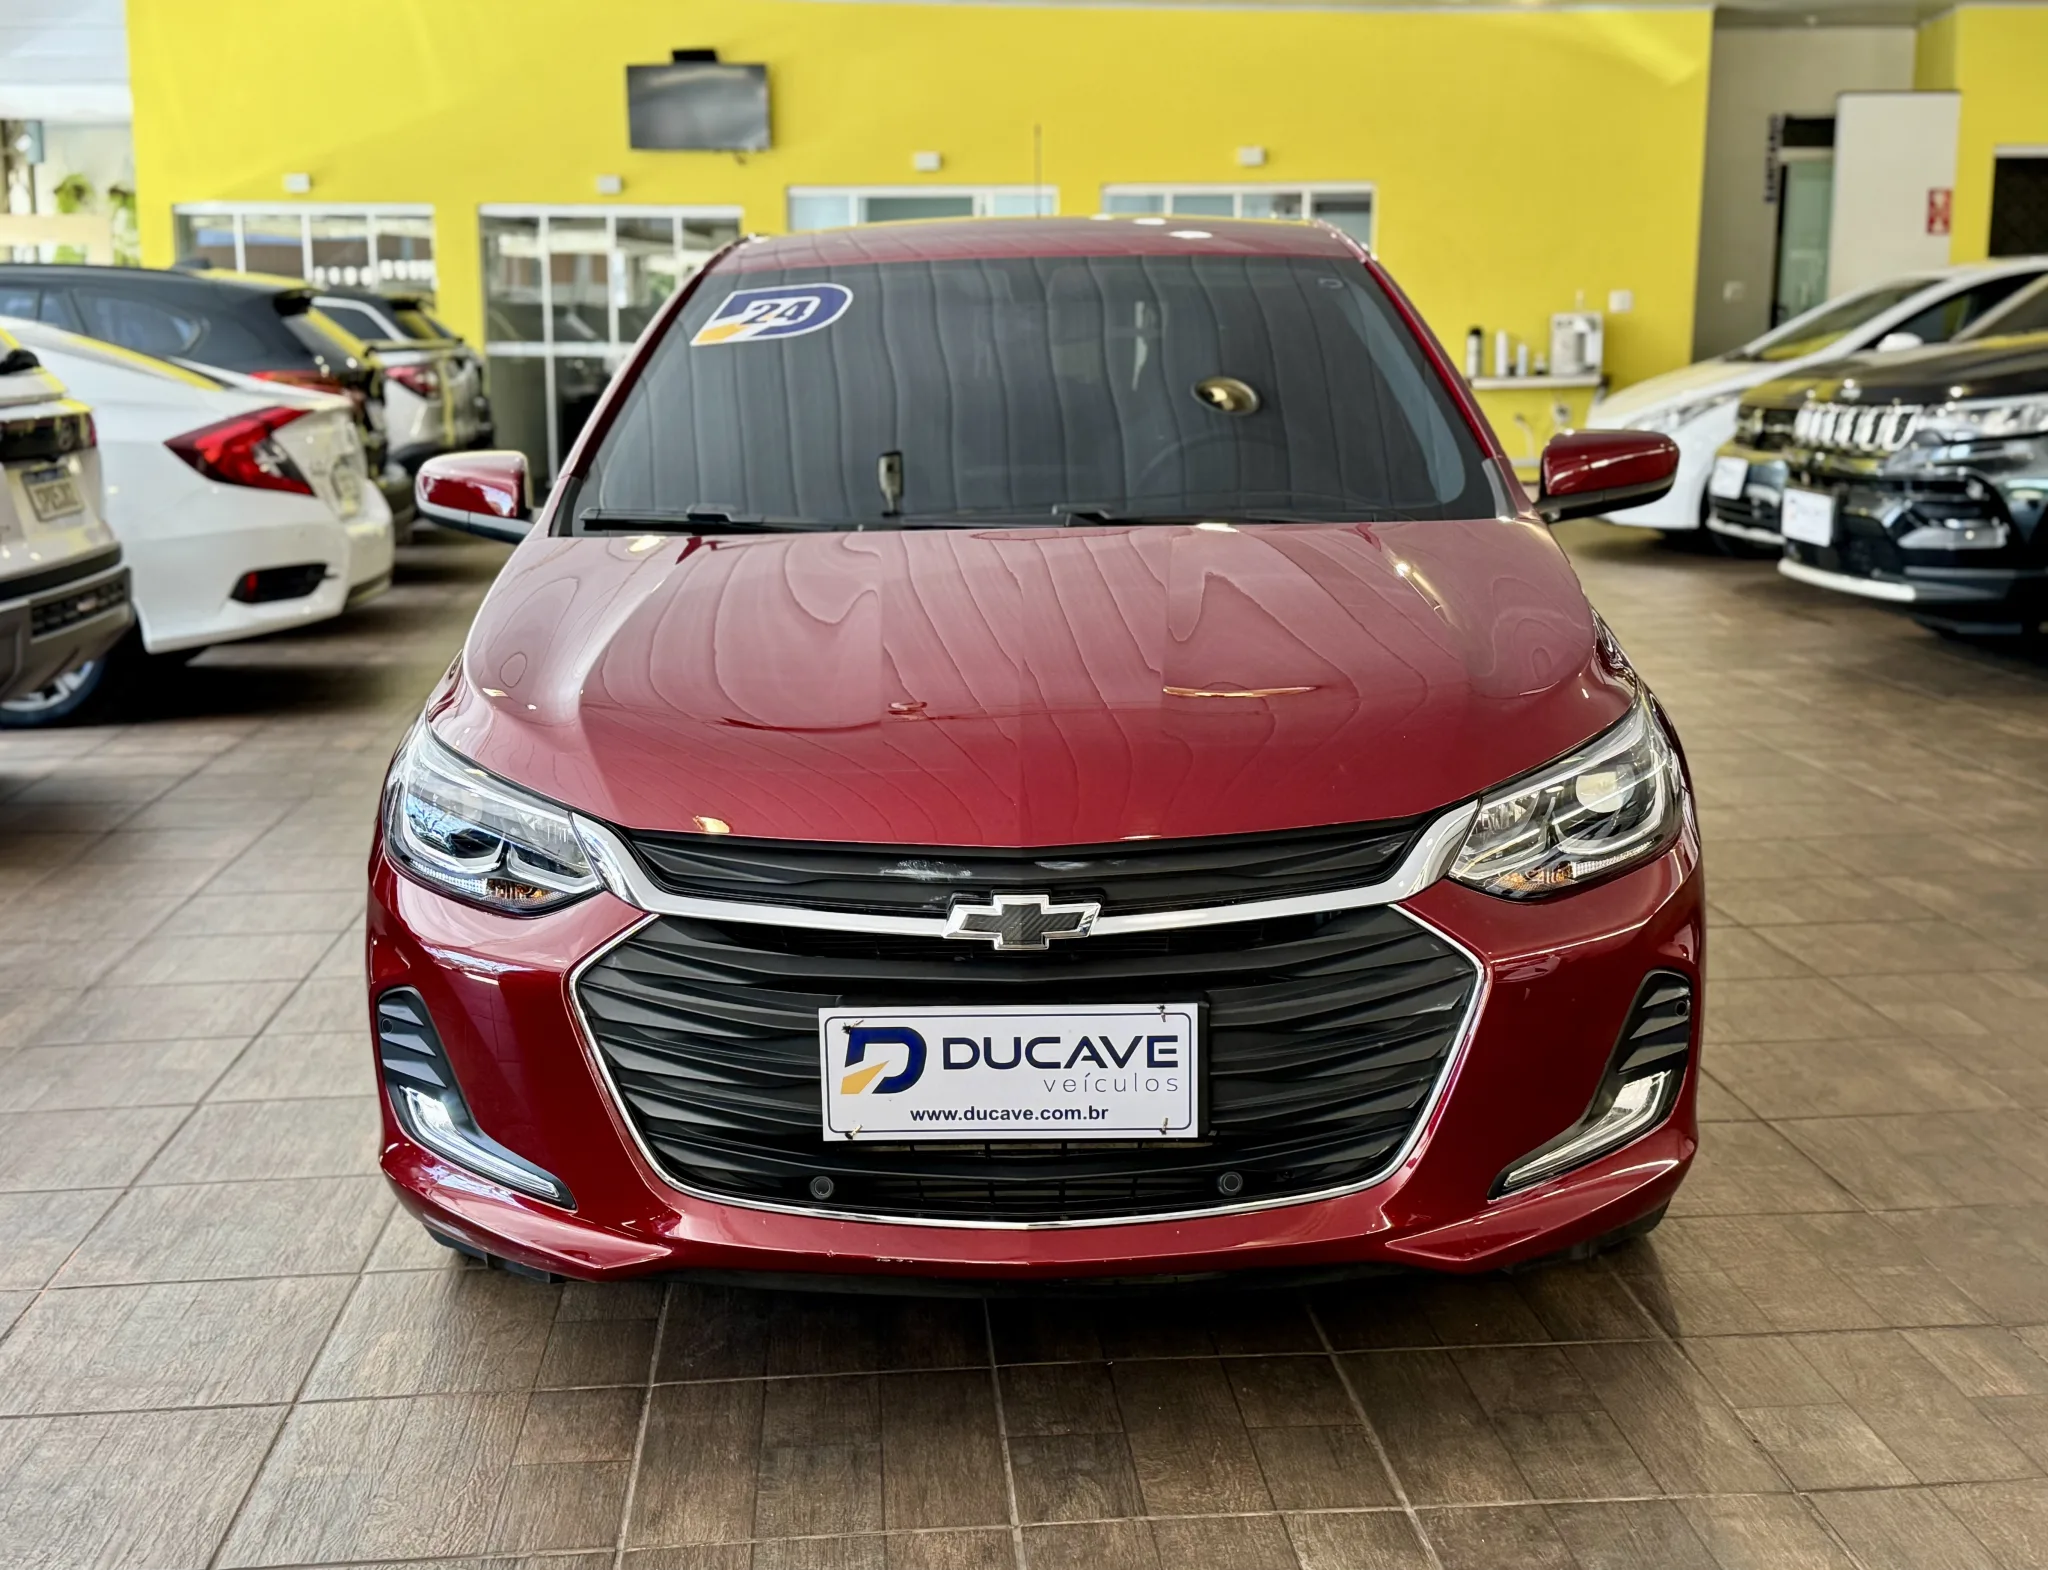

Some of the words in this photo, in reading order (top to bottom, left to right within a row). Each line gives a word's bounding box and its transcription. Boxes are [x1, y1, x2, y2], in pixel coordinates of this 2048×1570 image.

[741, 300, 811, 325] 24
[942, 1034, 1179, 1071] DUCAVE
[1043, 1073, 1178, 1093] veículos
[909, 1104, 1110, 1122] www.ducave.com.br
